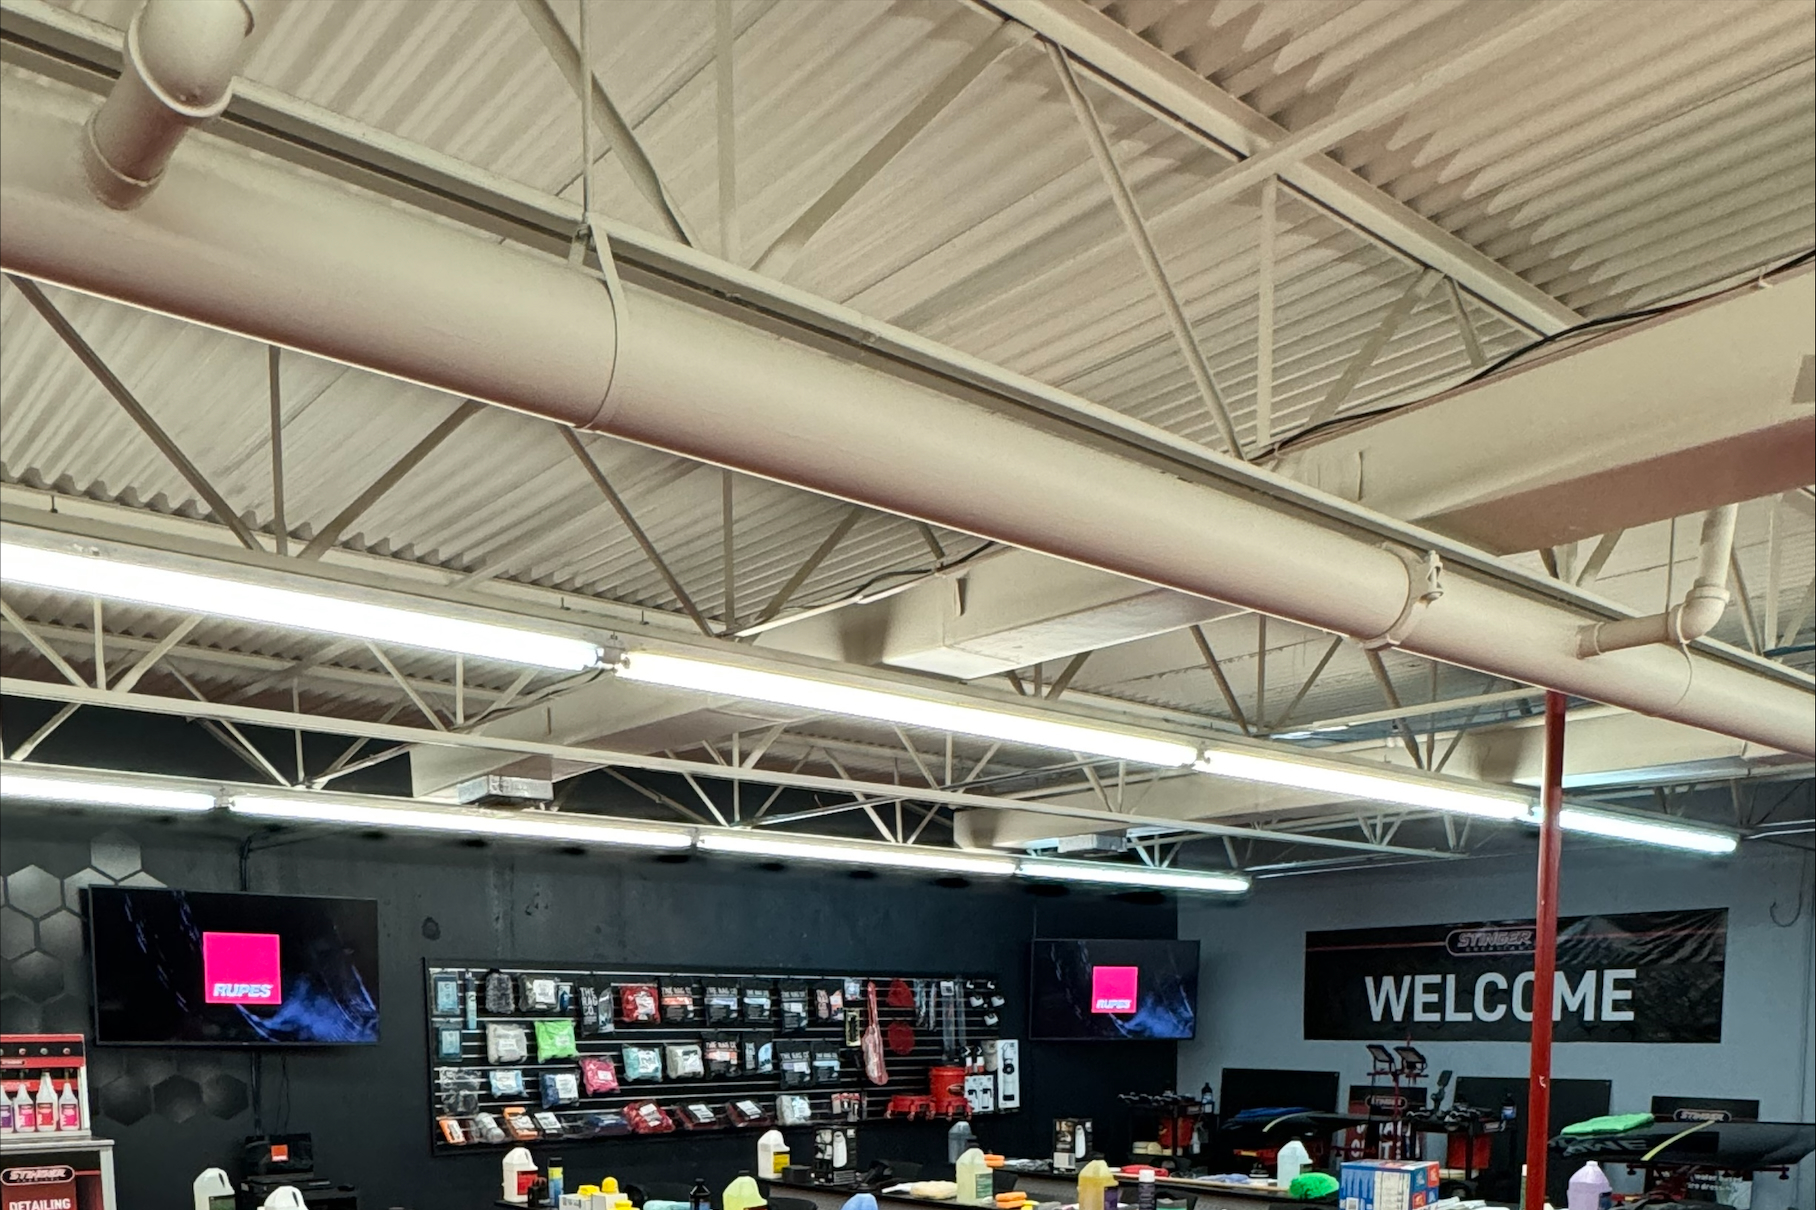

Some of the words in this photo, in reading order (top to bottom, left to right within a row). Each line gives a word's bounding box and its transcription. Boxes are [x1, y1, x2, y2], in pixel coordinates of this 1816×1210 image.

[1457, 930, 1534, 948] STINGER
[213, 983, 273, 998] RUPES
[1364, 968, 1637, 1023] WELCOME
